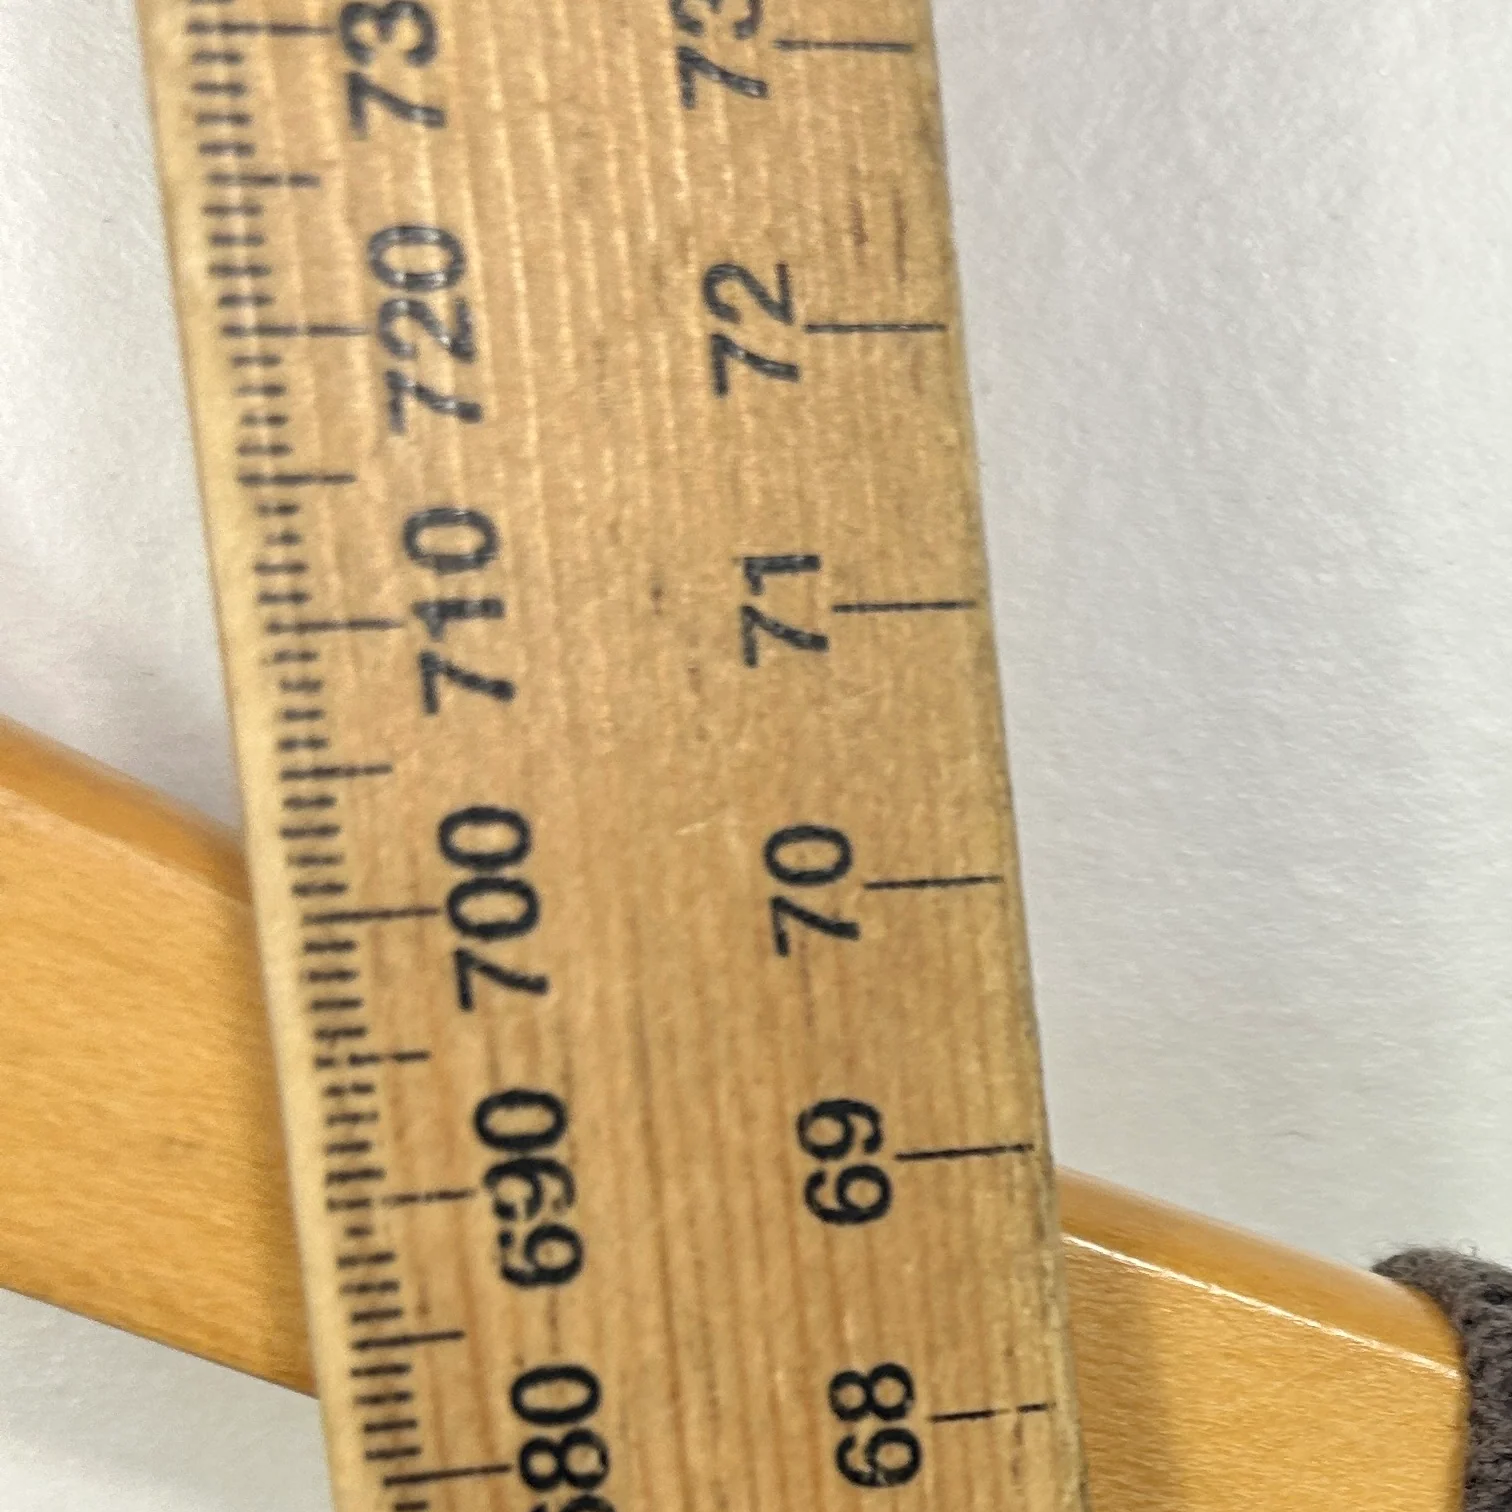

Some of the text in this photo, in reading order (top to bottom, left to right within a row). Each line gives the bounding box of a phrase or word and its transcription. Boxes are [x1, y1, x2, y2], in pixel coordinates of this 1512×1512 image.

[367, 224, 483, 435] 720
[702, 262, 801, 395] 72
[404, 506, 517, 715] 710
[735, 553, 829, 668] 71
[438, 806, 550, 1010] 700
[762, 824, 860, 957] 70
[474, 1089, 585, 1288] 690
[794, 1097, 894, 1225] 69
[827, 1362, 924, 1488] 68
